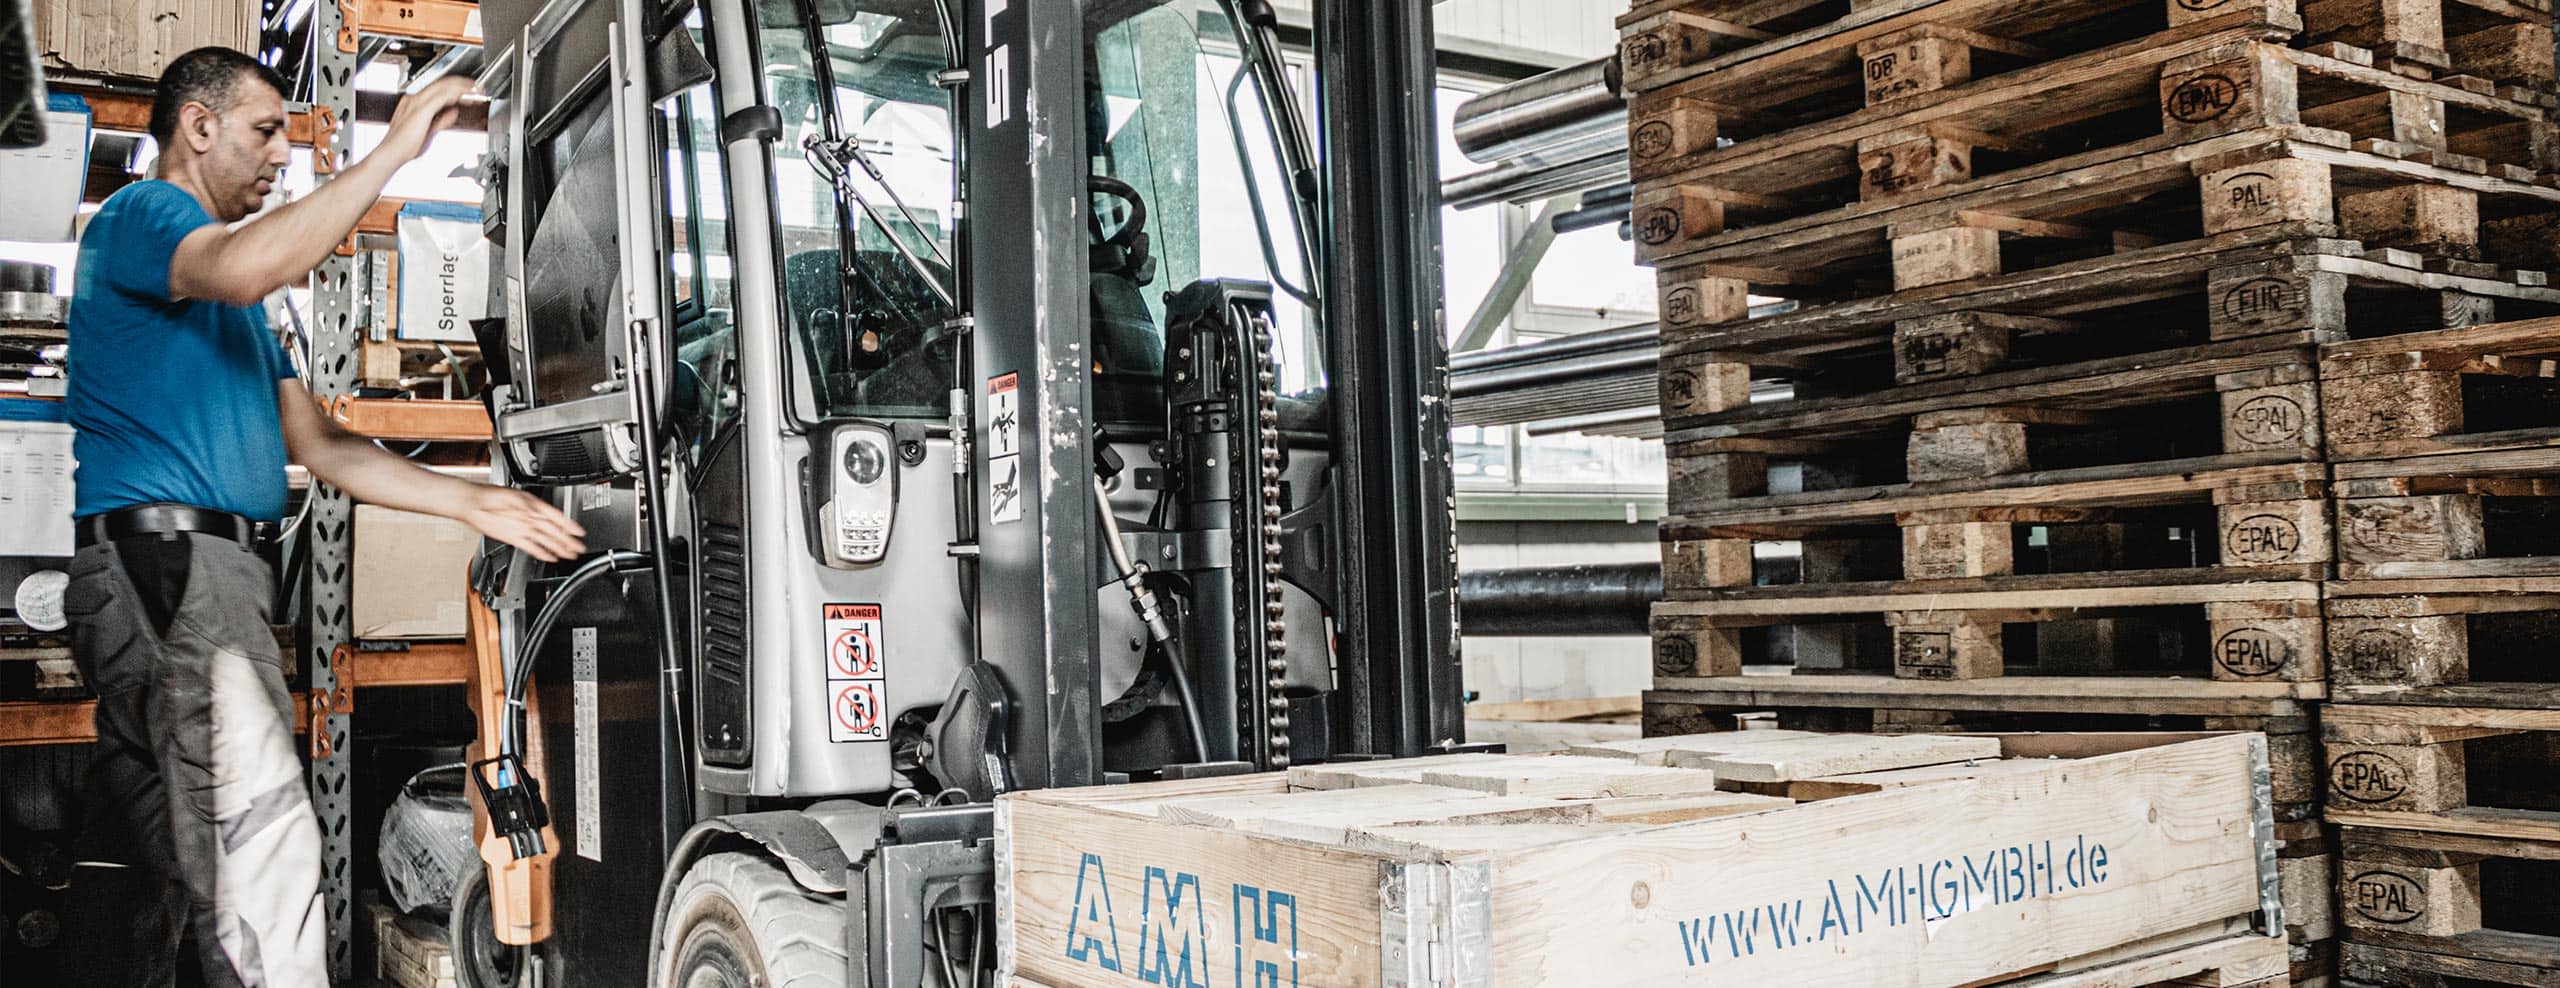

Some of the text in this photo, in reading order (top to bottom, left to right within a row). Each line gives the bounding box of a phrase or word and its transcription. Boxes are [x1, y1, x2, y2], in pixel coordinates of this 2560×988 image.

[2179, 84, 2229, 117] EPAL
[2245, 405, 2294, 434] EPAL
[2239, 525, 2288, 554] EPAL
[844, 607, 878, 618] DANGER
[2225, 639, 2277, 668] EPAL
[2341, 762, 2396, 792] EPAL
[2358, 881, 2415, 914] EPAL
[1065, 852, 1300, 988] AMH
